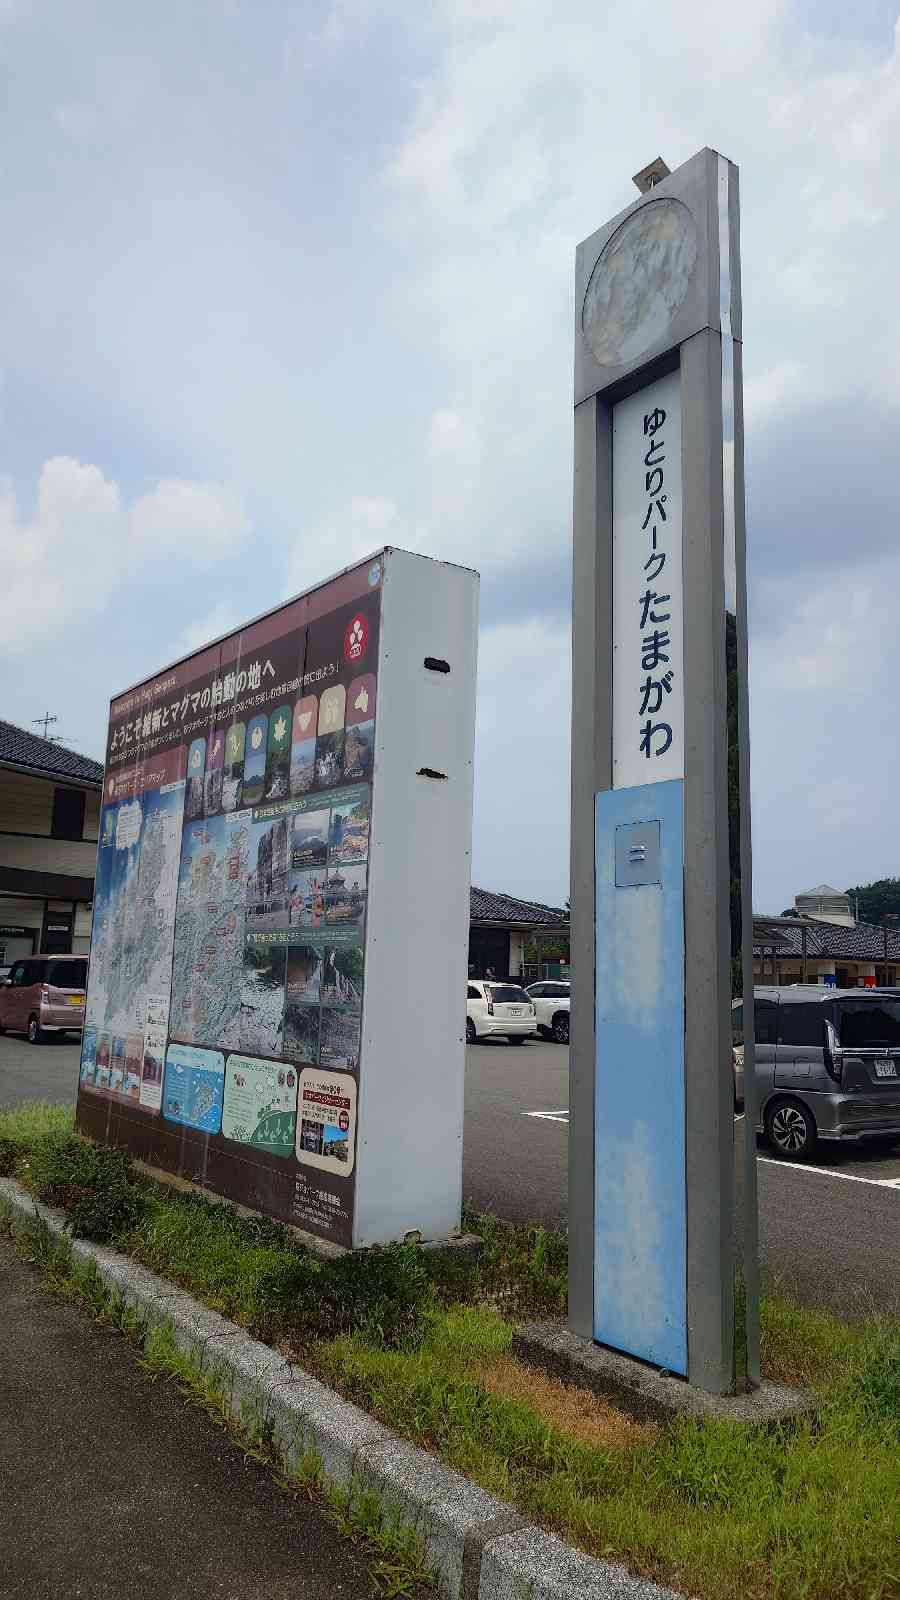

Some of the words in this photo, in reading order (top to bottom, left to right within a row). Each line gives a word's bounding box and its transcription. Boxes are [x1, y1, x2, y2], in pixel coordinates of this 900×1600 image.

[639, 407, 674, 759] ゆとりパークたまがわ
